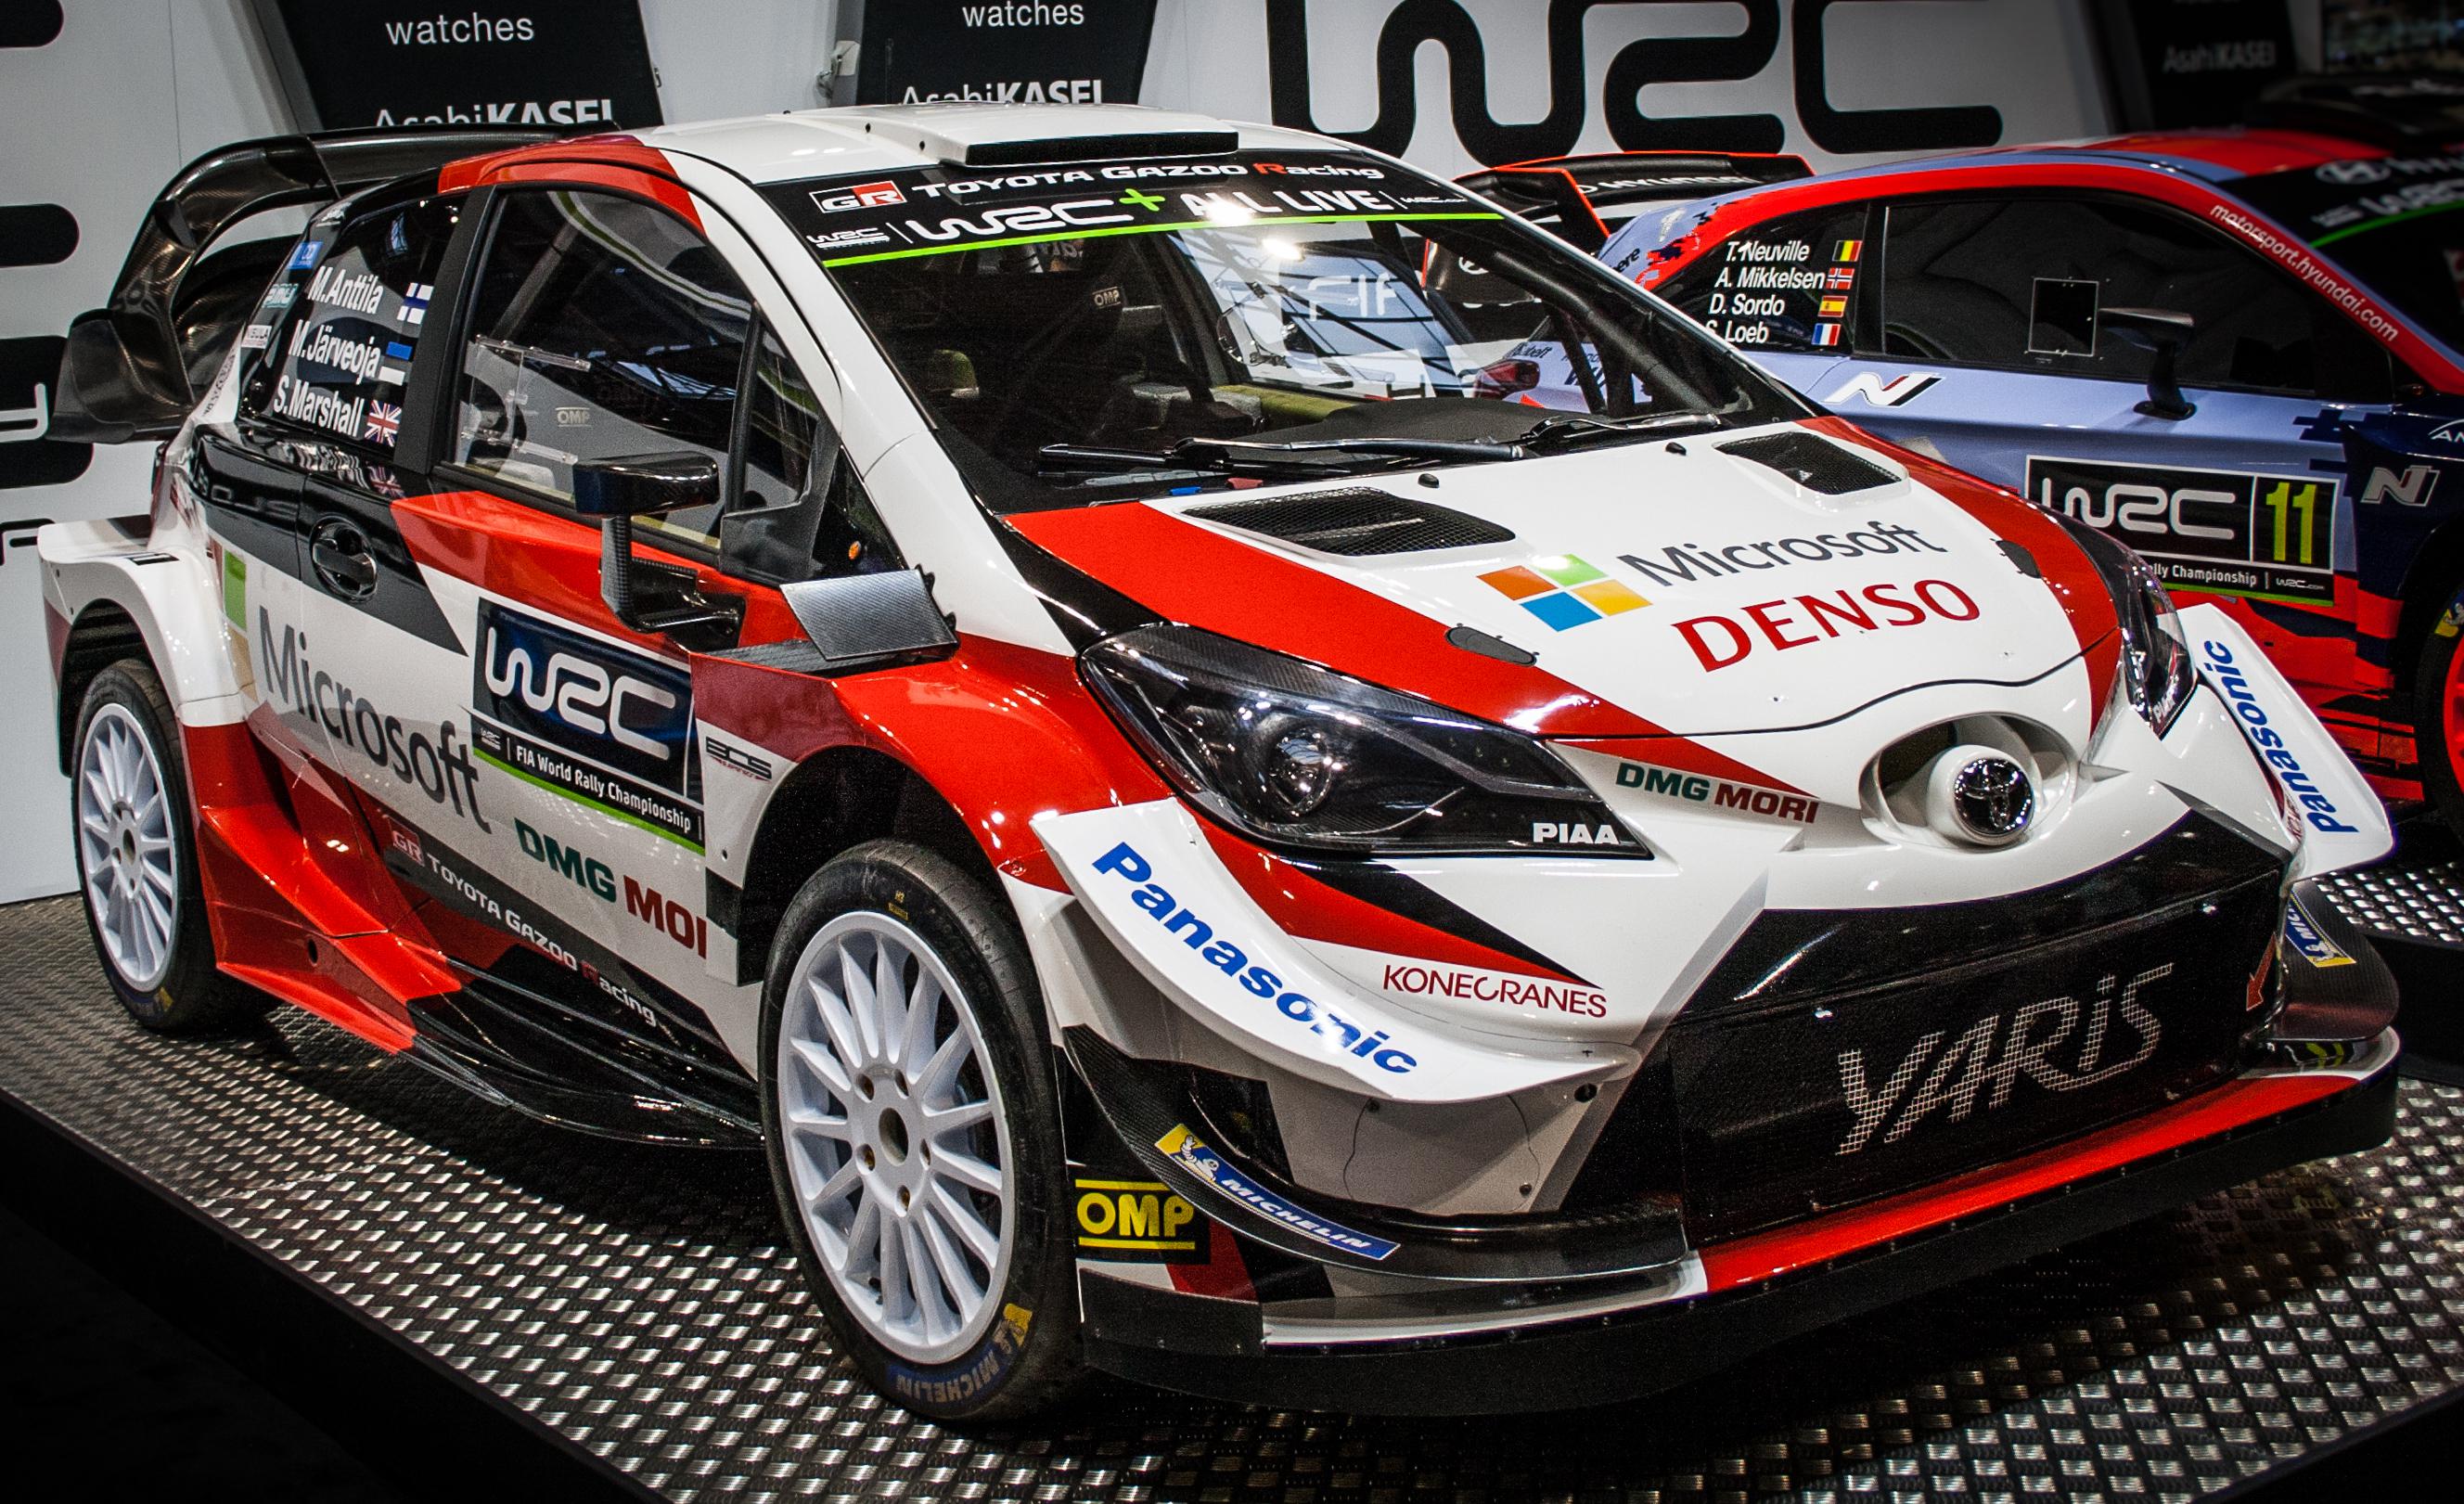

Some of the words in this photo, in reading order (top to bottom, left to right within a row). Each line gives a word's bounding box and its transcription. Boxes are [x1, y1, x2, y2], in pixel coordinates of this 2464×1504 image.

[385, 12, 534, 45] watches
[962, 0, 1084, 27] watches
[820, 188, 904, 212] GR
[911, 170, 1095, 198] TOYOTA
[1102, 163, 1249, 180] GAZOO
[1253, 162, 1384, 179] Racing
[1272, 190, 1394, 212] LIVE
[1714, 267, 1732, 289] A.
[1737, 266, 1826, 289] Mikkelsen
[1739, 240, 1810, 262] Neuville
[2210, 203, 2398, 341] motorsport.hyundai.com
[1709, 293, 1726, 315] D.
[1732, 293, 1785, 316] Sordo
[1724, 319, 1770, 344] Loeb
[288, 319, 381, 385] M.Järveoja
[273, 375, 365, 437] S.Marshall
[2042, 477, 2237, 541] WRC
[2265, 482, 2317, 565] 11
[1616, 521, 1948, 586] Microsoft
[2172, 565, 2257, 587] Championship
[1671, 579, 1981, 672] DENSO
[259, 605, 494, 834] Microsoft
[485, 626, 675, 761] WRC
[2203, 640, 2360, 833] Panasonic
[516, 744, 536, 767] FIA
[536, 752, 571, 782] World
[575, 769, 605, 798] Rally
[608, 782, 691, 833] Championship
[1615, 762, 1711, 801] DMG
[1714, 782, 1820, 824] MORI
[513, 816, 617, 904] DMG
[1533, 821, 1620, 845] PIAA
[427, 853, 502, 920] TOYOTA
[505, 907, 578, 971] GAZOO
[581, 959, 657, 1027] Racing
[1091, 841, 1418, 1073] Panasonic
[1383, 964, 1607, 1018] KONECRANES
[1076, 1191, 1195, 1239] OMP
[1221, 1178, 1373, 1249] MICHELIN
[895, 1349, 1000, 1404] MICHELIN
